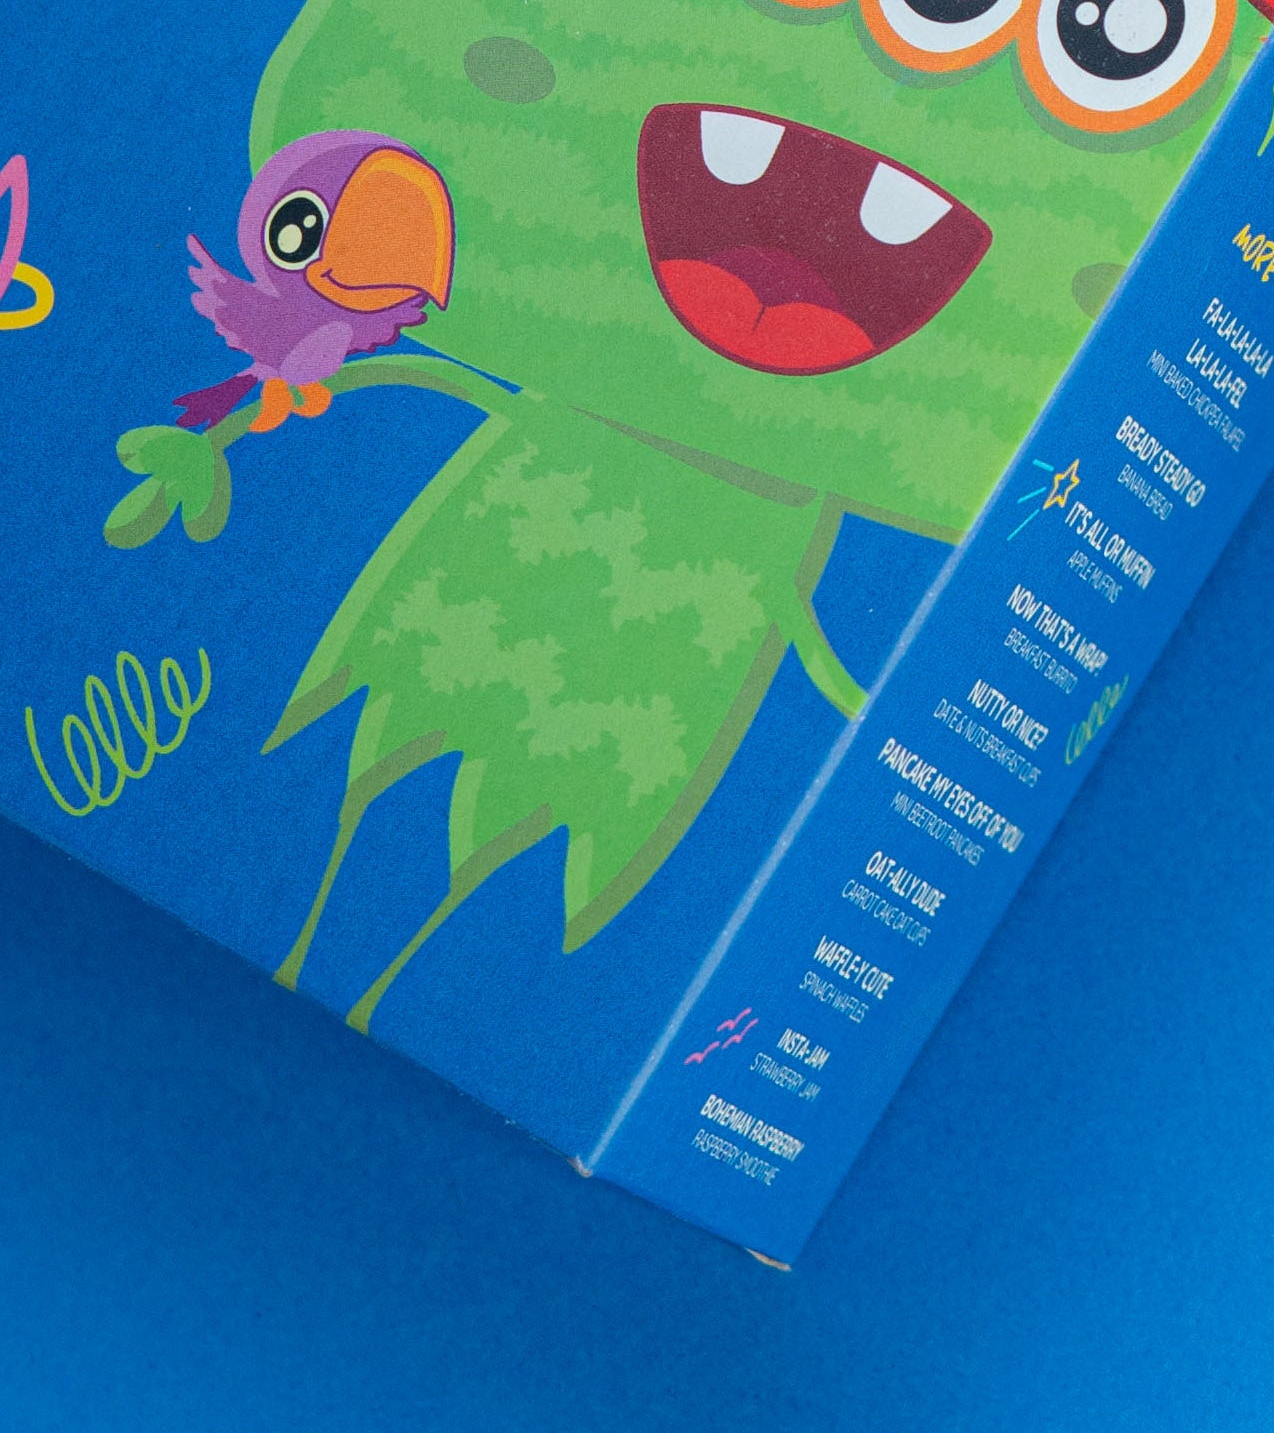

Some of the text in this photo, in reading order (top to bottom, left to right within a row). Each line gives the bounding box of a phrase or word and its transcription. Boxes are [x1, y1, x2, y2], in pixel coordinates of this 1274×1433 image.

[1147, 348, 1245, 451] MINI BAKED CHICKPEA FALAFEL
[1115, 415, 1206, 507] BREADY STEADY GO
[1116, 462, 1173, 521] BANANA BREAD
[1064, 500, 1155, 588] IT'S ALL OR MUFFIN
[1066, 549, 1122, 603] APPLE MUFFINS
[1006, 583, 1042, 621] NOW
[1034, 603, 1075, 648] THAT'S
[1064, 632, 1081, 655] A
[1003, 626, 1078, 694] BREAKFAST BURRITO
[932, 697, 1041, 788] DATE & NUTS BREAKFAST CUPS
[966, 678, 1049, 749] NUTTY OR NICE?
[878, 737, 1023, 853] PANCAKE MY EYES OFF OF YOU
[890, 790, 984, 866] MINI BEETROOT PANCAKES
[840, 878, 931, 947] CARROT CAKE OAT CUPS
[864, 850, 946, 916] OAT-ALLY DUDE
[798, 970, 869, 1023] SPINACH WAFFLES
[813, 935, 894, 999] WAFFLE-Y CUTE
[749, 1051, 821, 1099] STRAWBERRY JAM
[777, 1028, 829, 1068] INSTA-JAM
[692, 1128, 779, 1186] RASPBERRY SMOOTHIE
[700, 1093, 804, 1159] BOHEMIAN RASPBERRY
